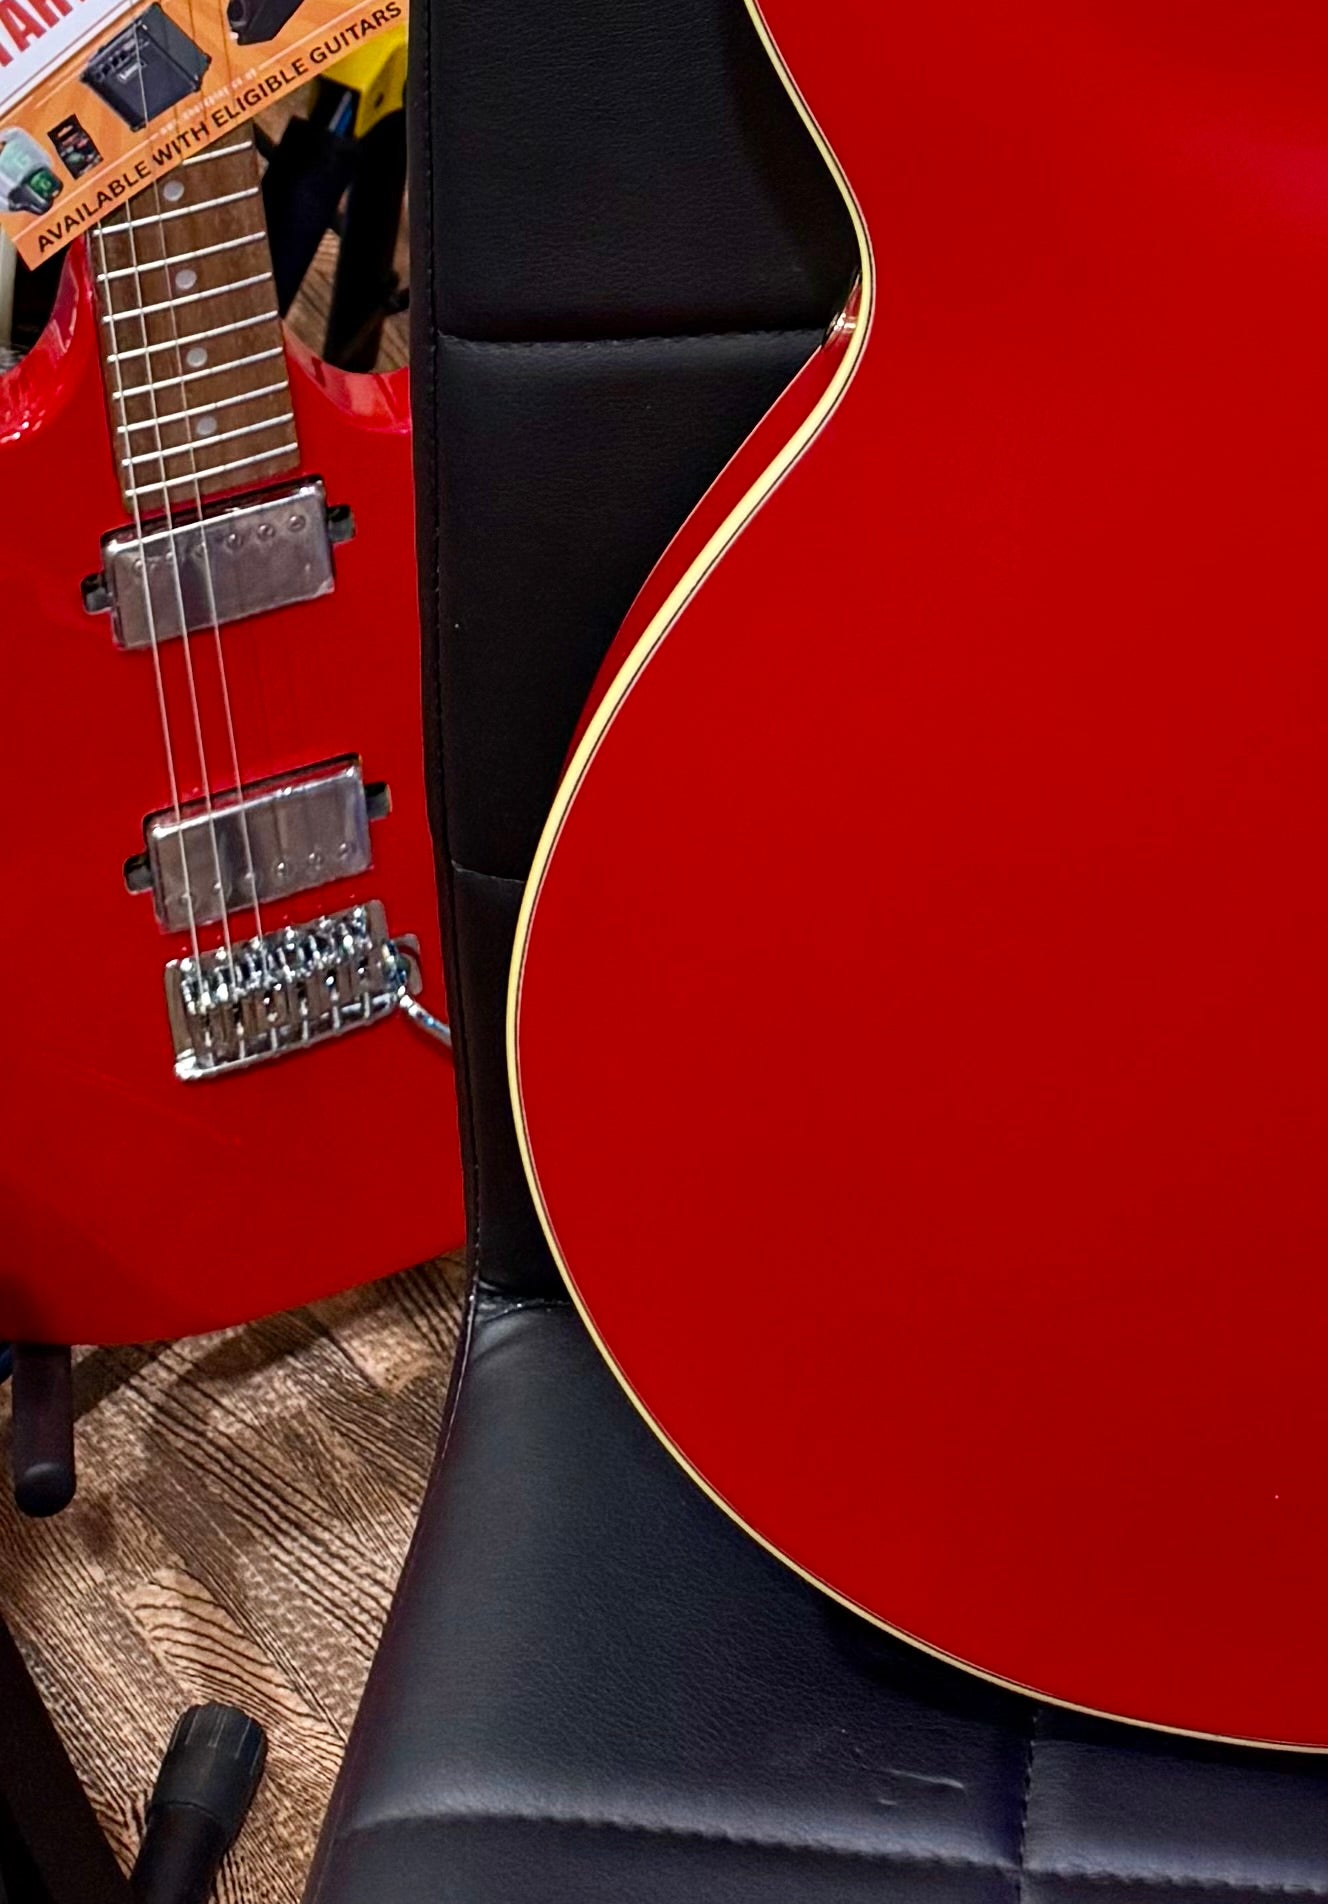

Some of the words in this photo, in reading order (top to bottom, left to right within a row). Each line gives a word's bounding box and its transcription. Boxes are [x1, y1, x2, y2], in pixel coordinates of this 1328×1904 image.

[37, 160, 152, 254] AVAILABLE
[152, 120, 211, 167] WITH
[211, 57, 309, 129] ELIGIBLE
[309, 1, 403, 65] GUITARS
